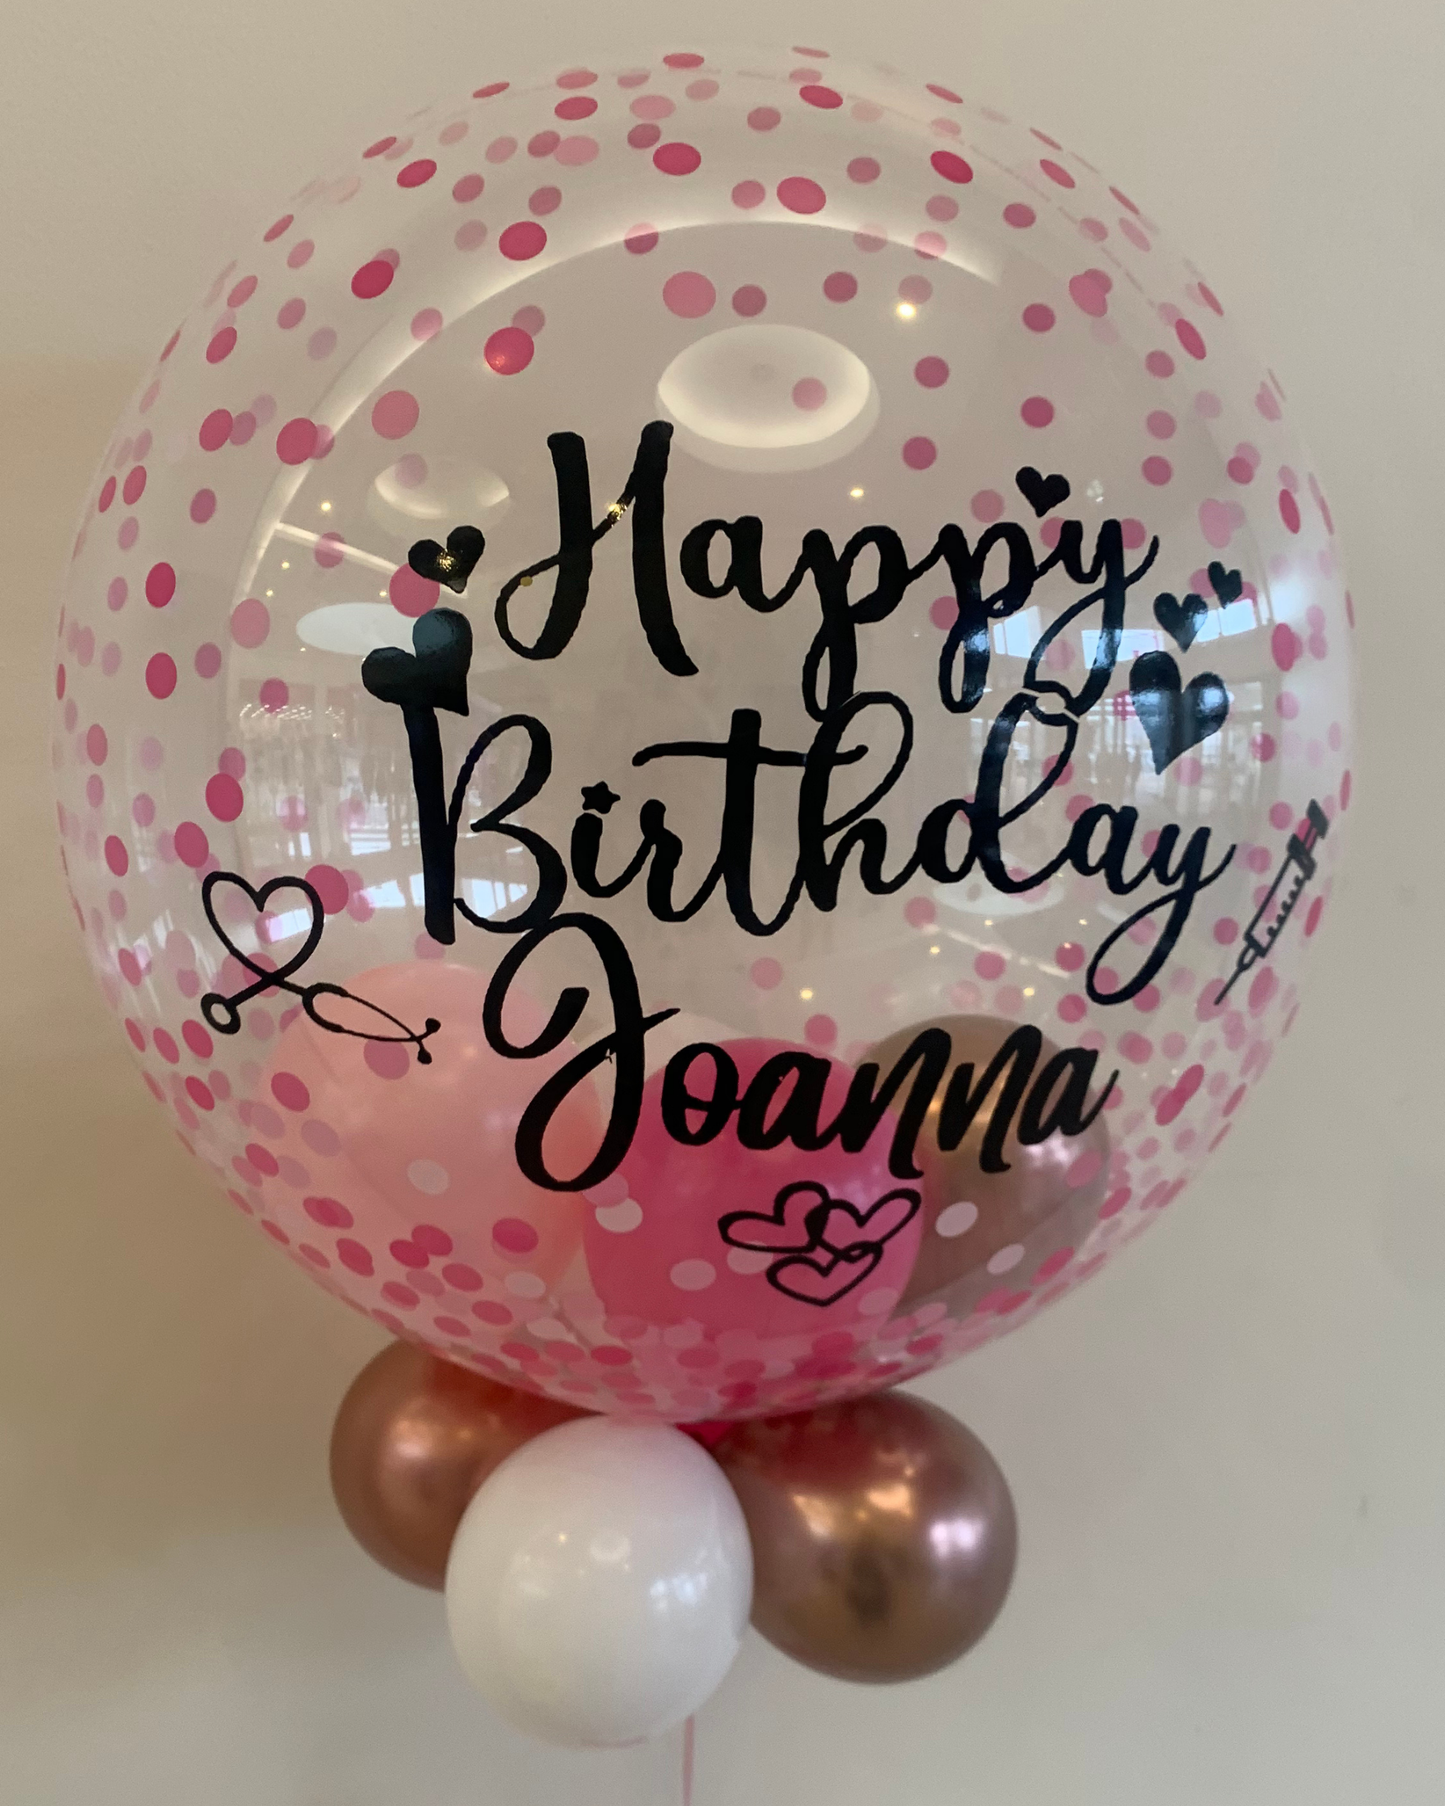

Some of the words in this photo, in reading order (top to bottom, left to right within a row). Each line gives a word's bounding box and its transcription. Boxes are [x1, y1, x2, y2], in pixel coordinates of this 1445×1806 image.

[495, 420, 1159, 720] Happy
[402, 690, 1236, 1005] Birthday
[482, 912, 1120, 1193] Joanna
